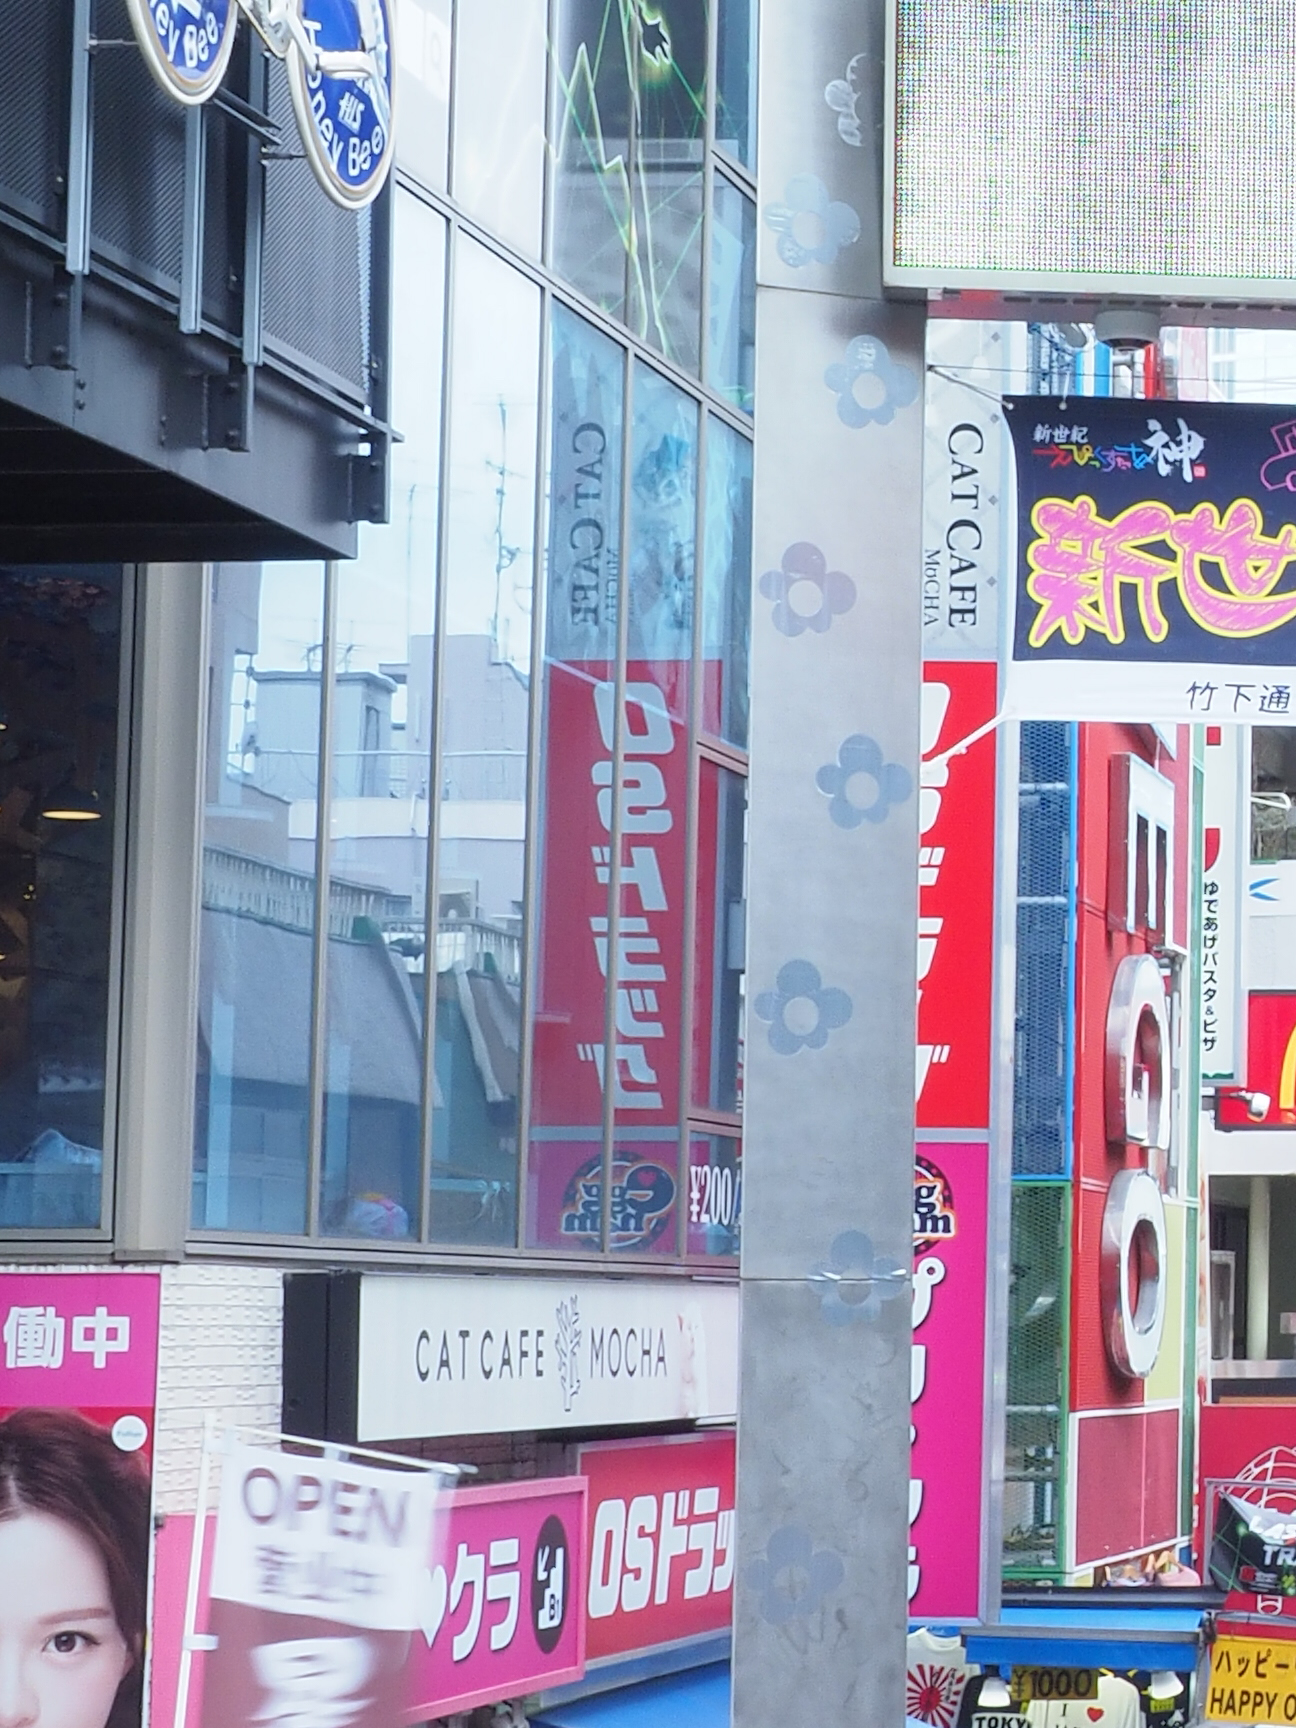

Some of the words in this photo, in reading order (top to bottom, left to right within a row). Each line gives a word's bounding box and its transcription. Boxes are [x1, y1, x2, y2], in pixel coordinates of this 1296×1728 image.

[948, 422, 985, 510] CAT
[945, 518, 983, 629] CAFE
[415, 1326, 469, 1383] CAT
[480, 1323, 546, 1380] CAFE
[590, 1326, 669, 1380] MOCHA
[1209, 1687, 1278, 1721] HAPPY
